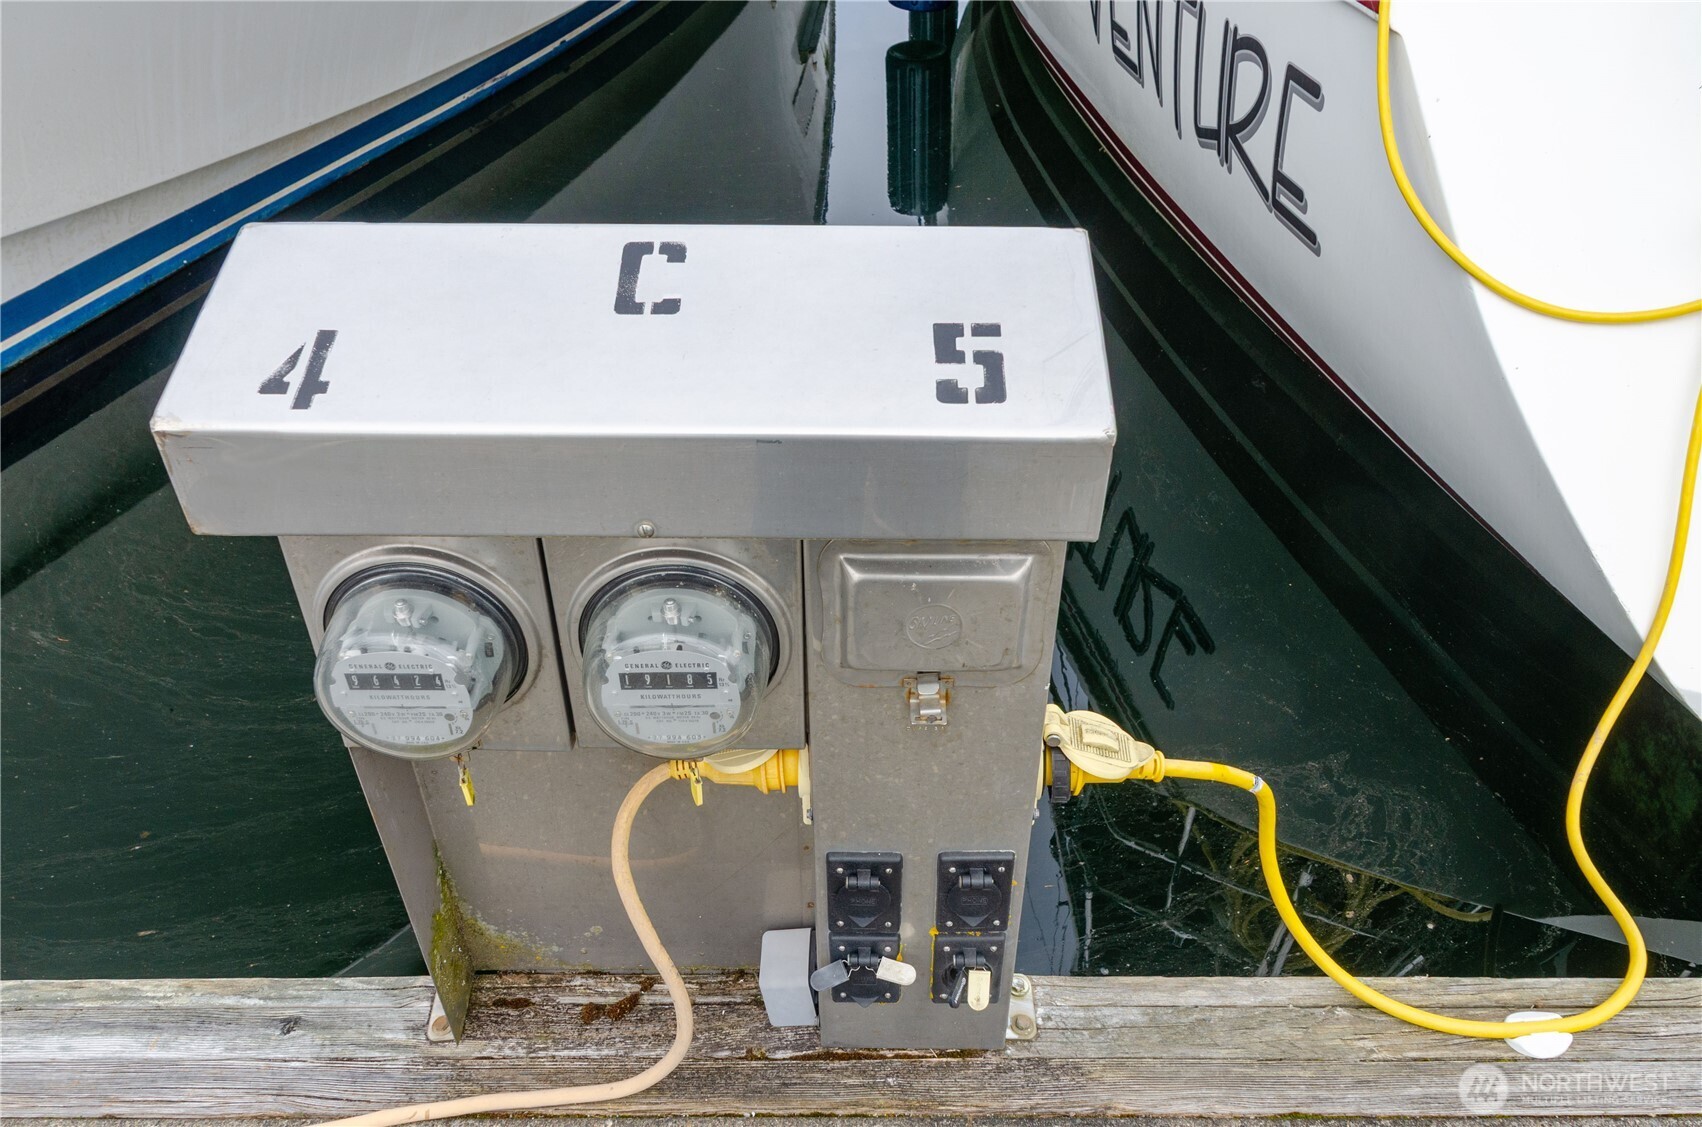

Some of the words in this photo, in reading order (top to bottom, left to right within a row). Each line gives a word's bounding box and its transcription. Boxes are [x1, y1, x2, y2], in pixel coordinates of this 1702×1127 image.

[613, 241, 688, 315] C
[257, 329, 338, 410] 4
[933, 322, 1007, 405] 5
[624, 673, 714, 687] 19185
